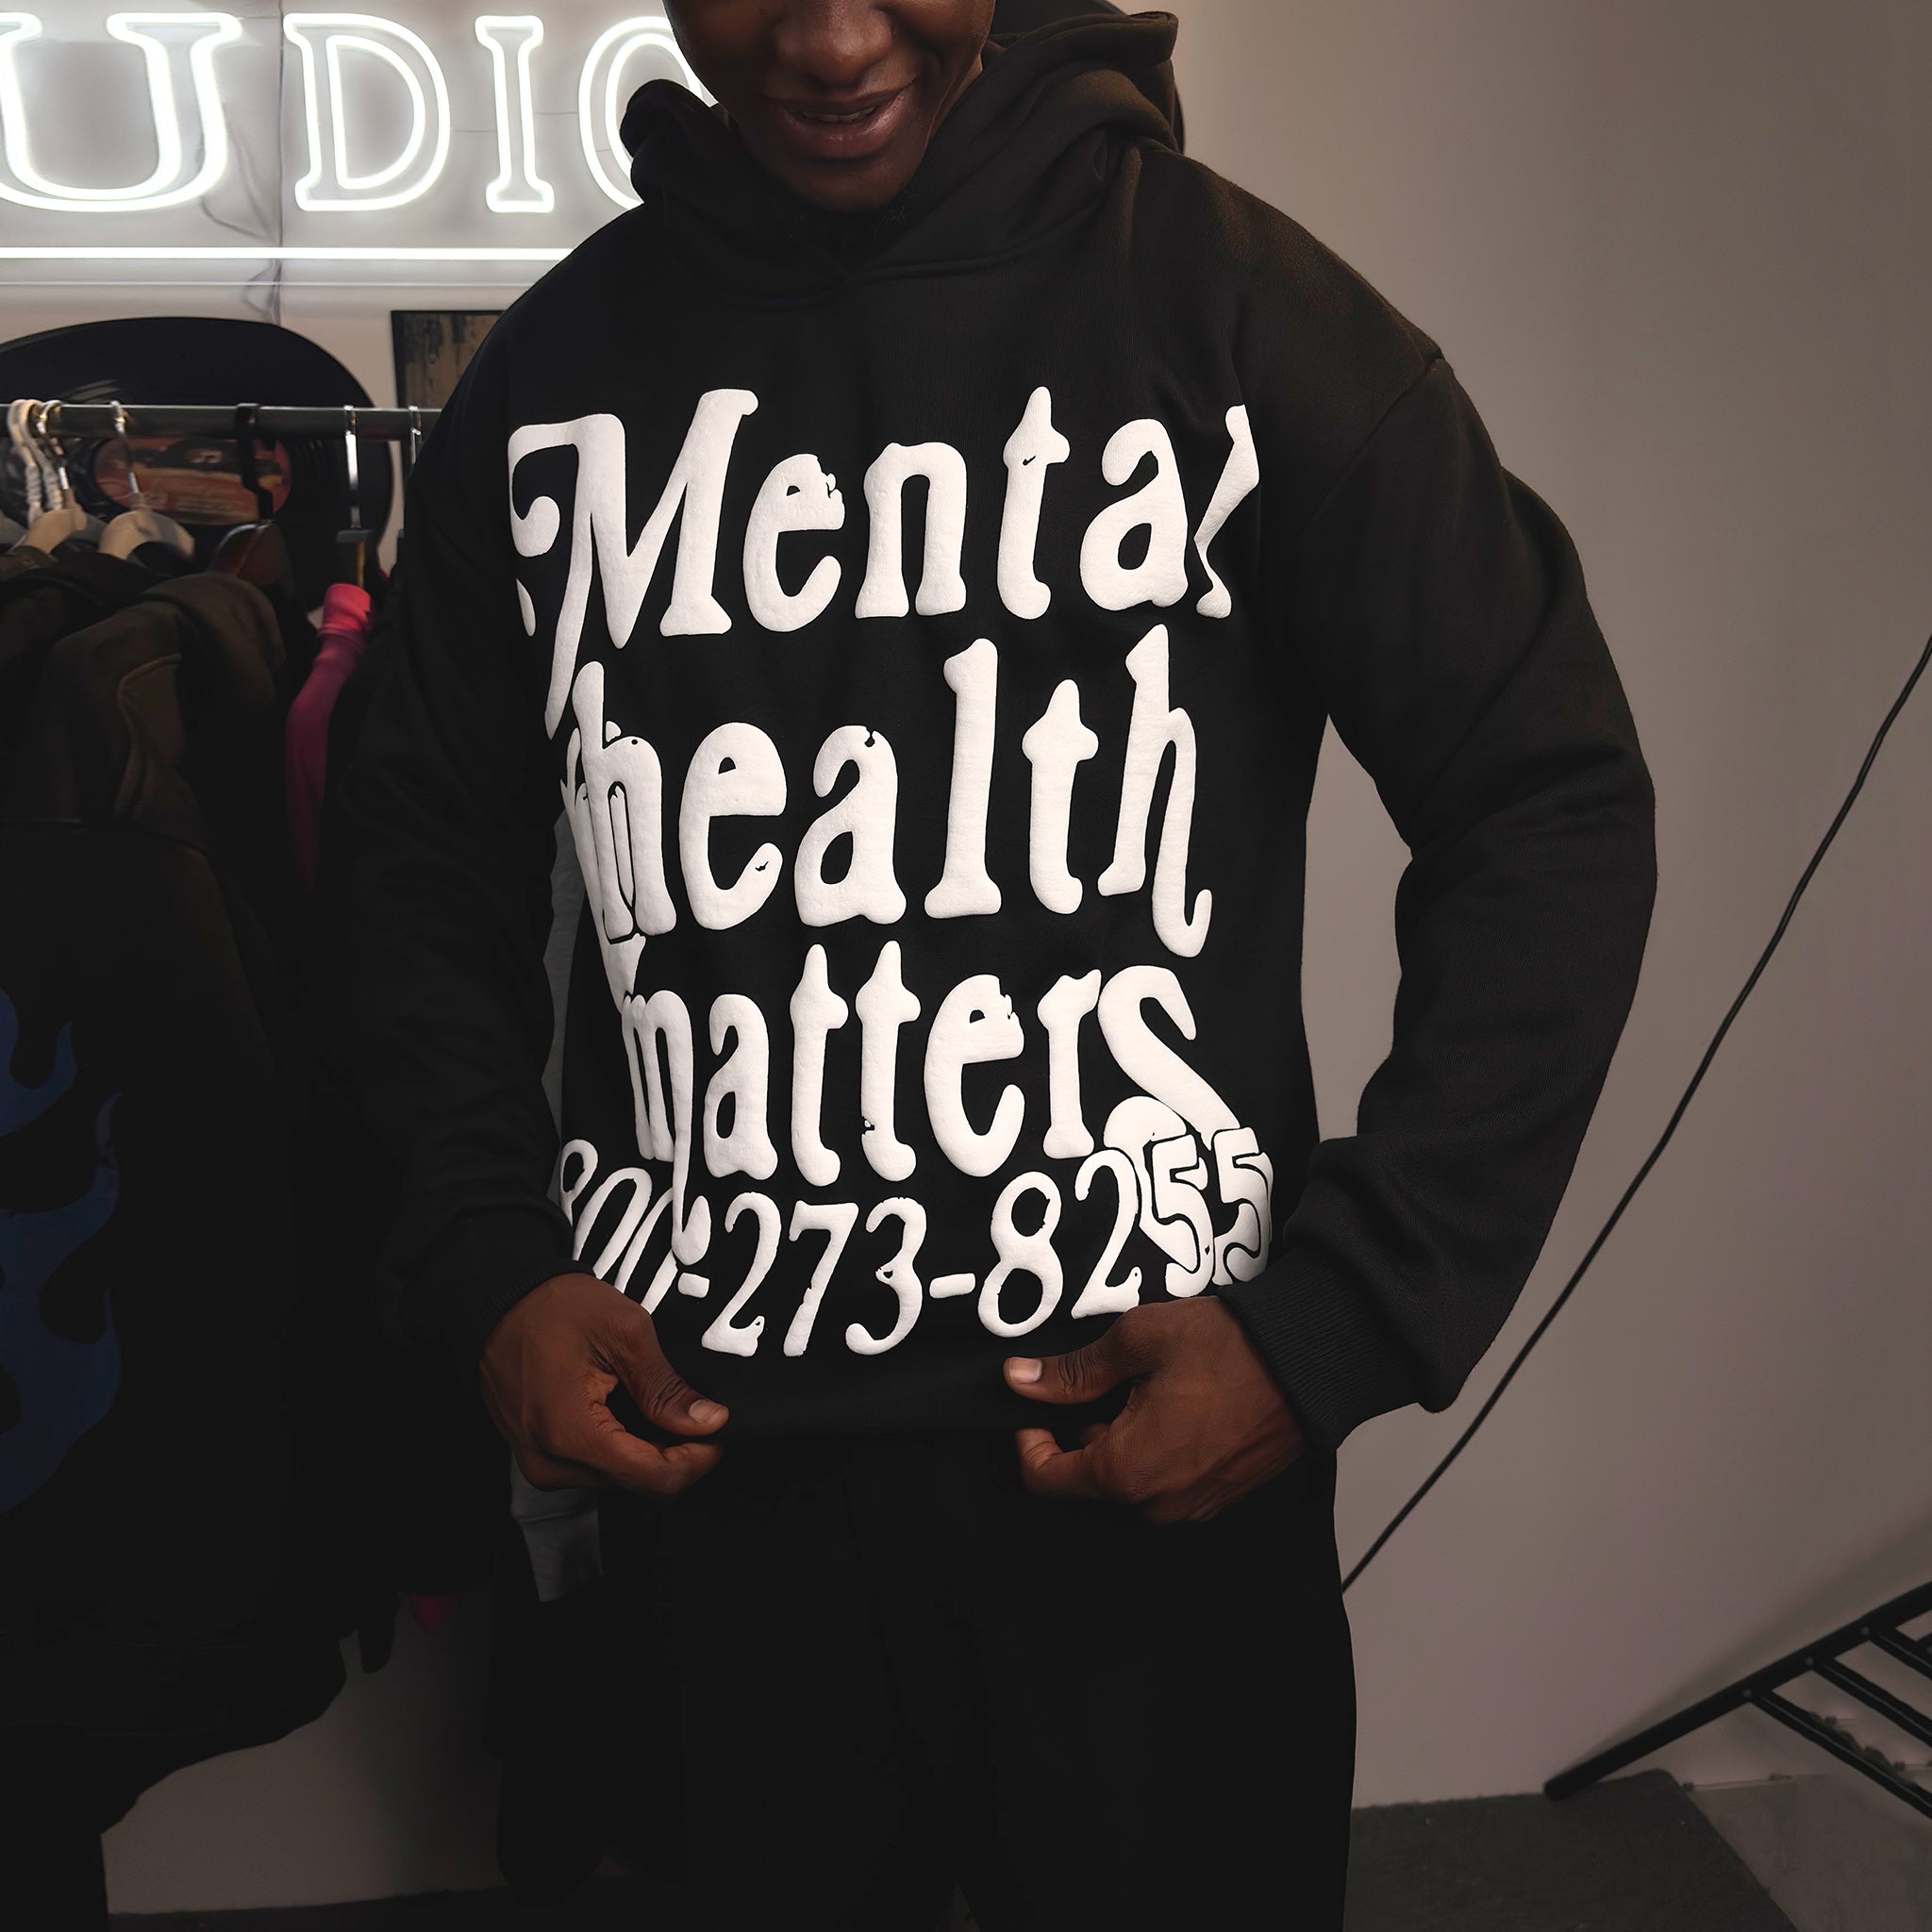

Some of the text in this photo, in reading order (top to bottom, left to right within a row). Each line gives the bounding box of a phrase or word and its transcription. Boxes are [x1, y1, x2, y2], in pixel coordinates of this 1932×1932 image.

[508, 386, 1261, 740] Mental
[563, 623, 1213, 958] health
[613, 940, 1241, 1266] matters
